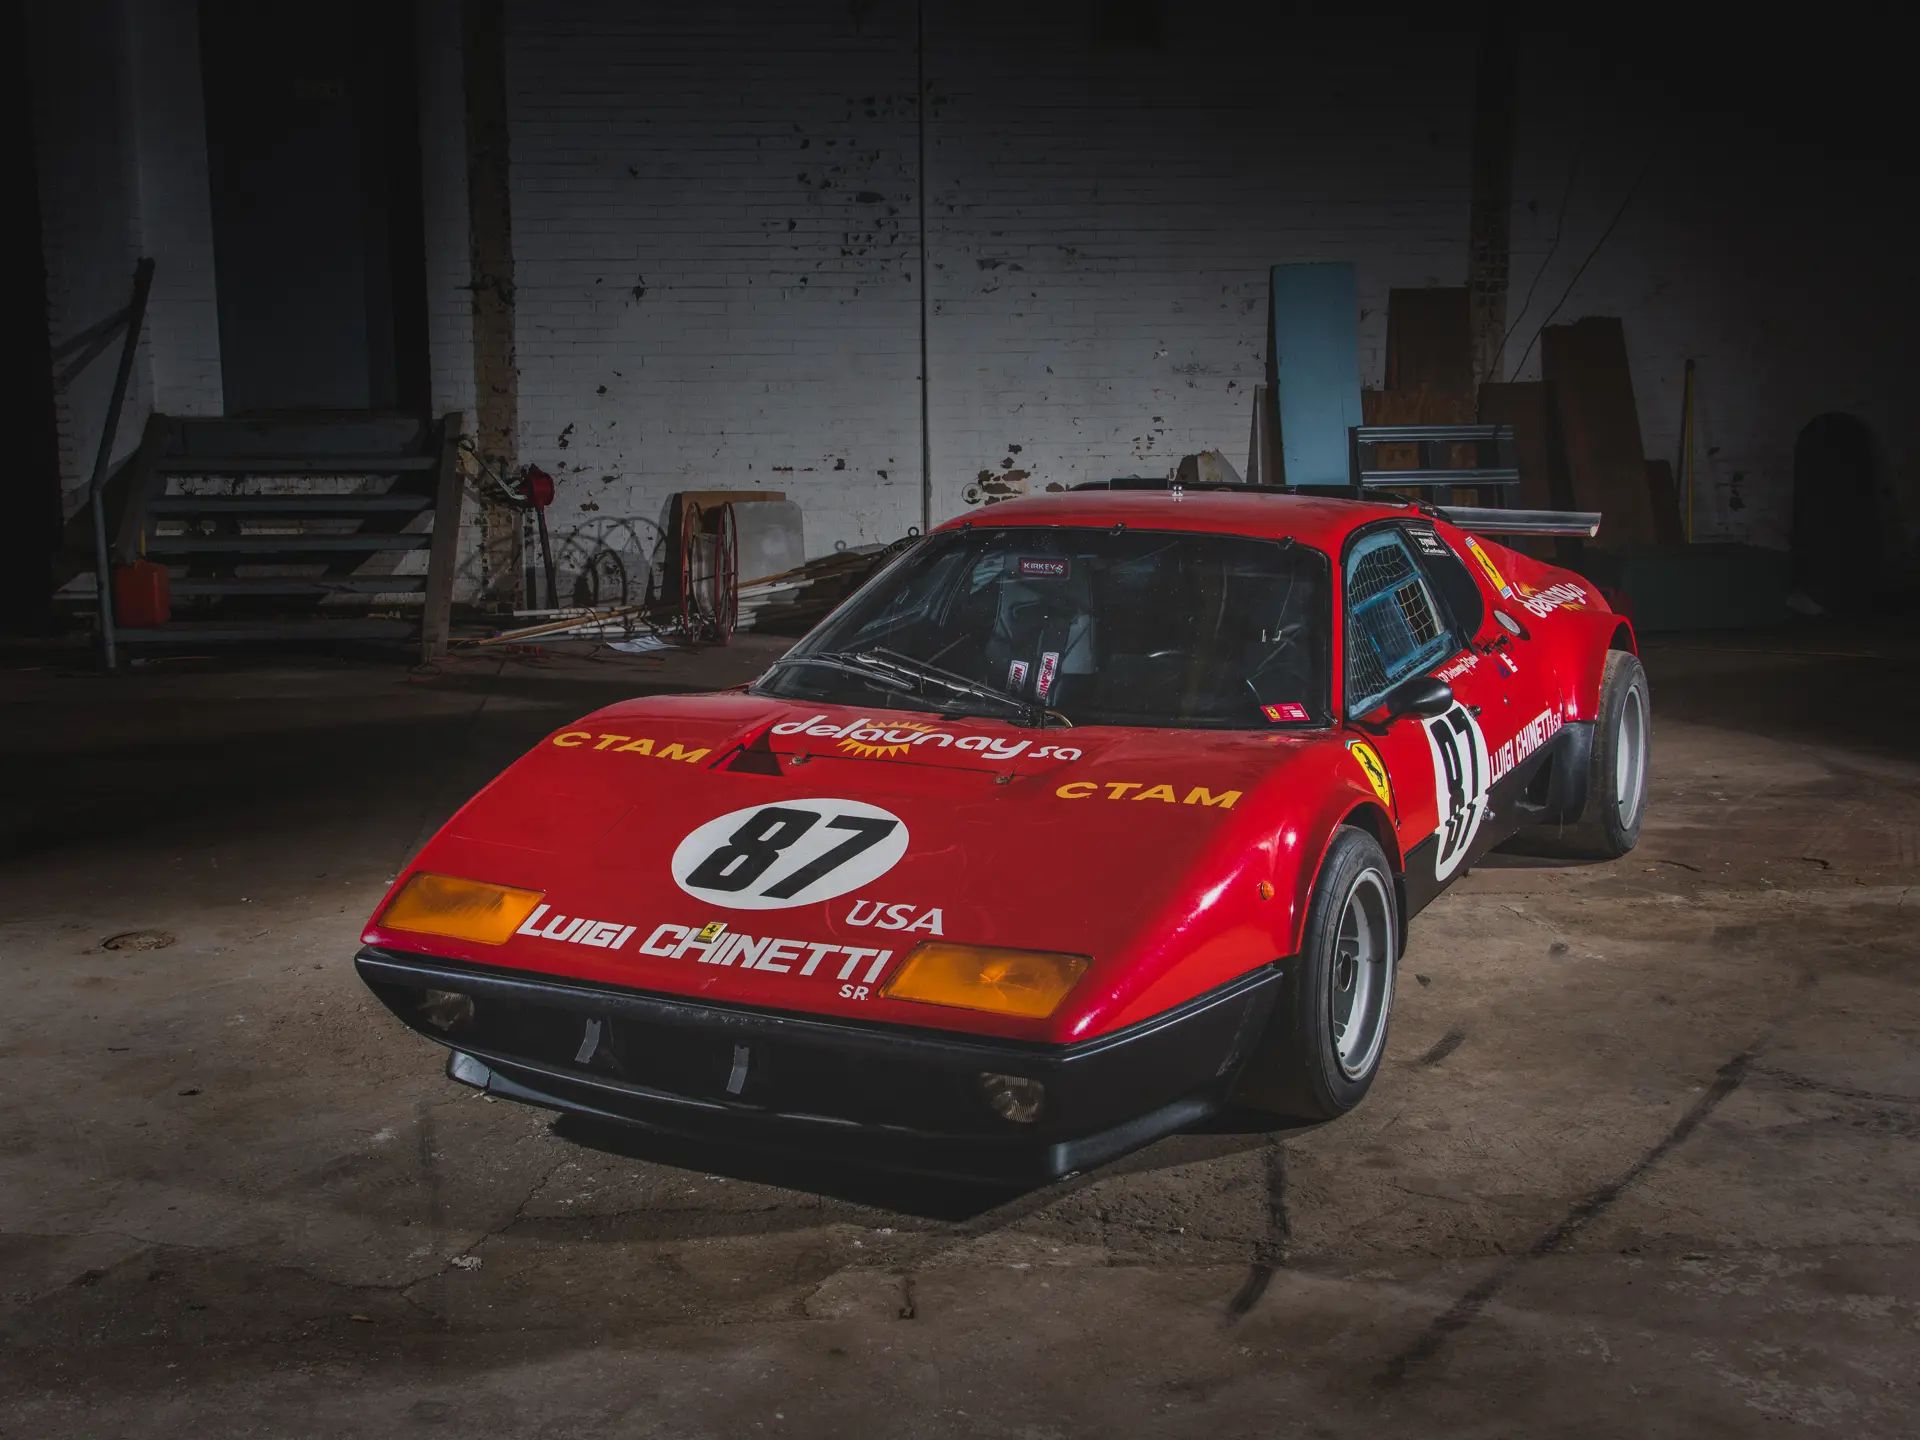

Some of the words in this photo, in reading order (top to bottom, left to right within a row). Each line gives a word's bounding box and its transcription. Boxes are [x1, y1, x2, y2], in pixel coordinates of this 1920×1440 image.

[1023, 562, 1056, 570] KIRKEY
[1039, 657, 1054, 699] SIMPSON
[552, 731, 713, 763] CTAM
[771, 715, 1033, 759] delaunay
[1028, 745, 1082, 761] sa
[1490, 739, 1515, 784] LUIGI
[1515, 708, 1553, 763] CHINETTI
[1055, 782, 1244, 809] CTAM
[1430, 706, 1479, 865] 87
[684, 806, 899, 900] 87
[845, 900, 943, 936] USA
[516, 904, 637, 949] LUIGI
[639, 923, 893, 983] CHINETTI
